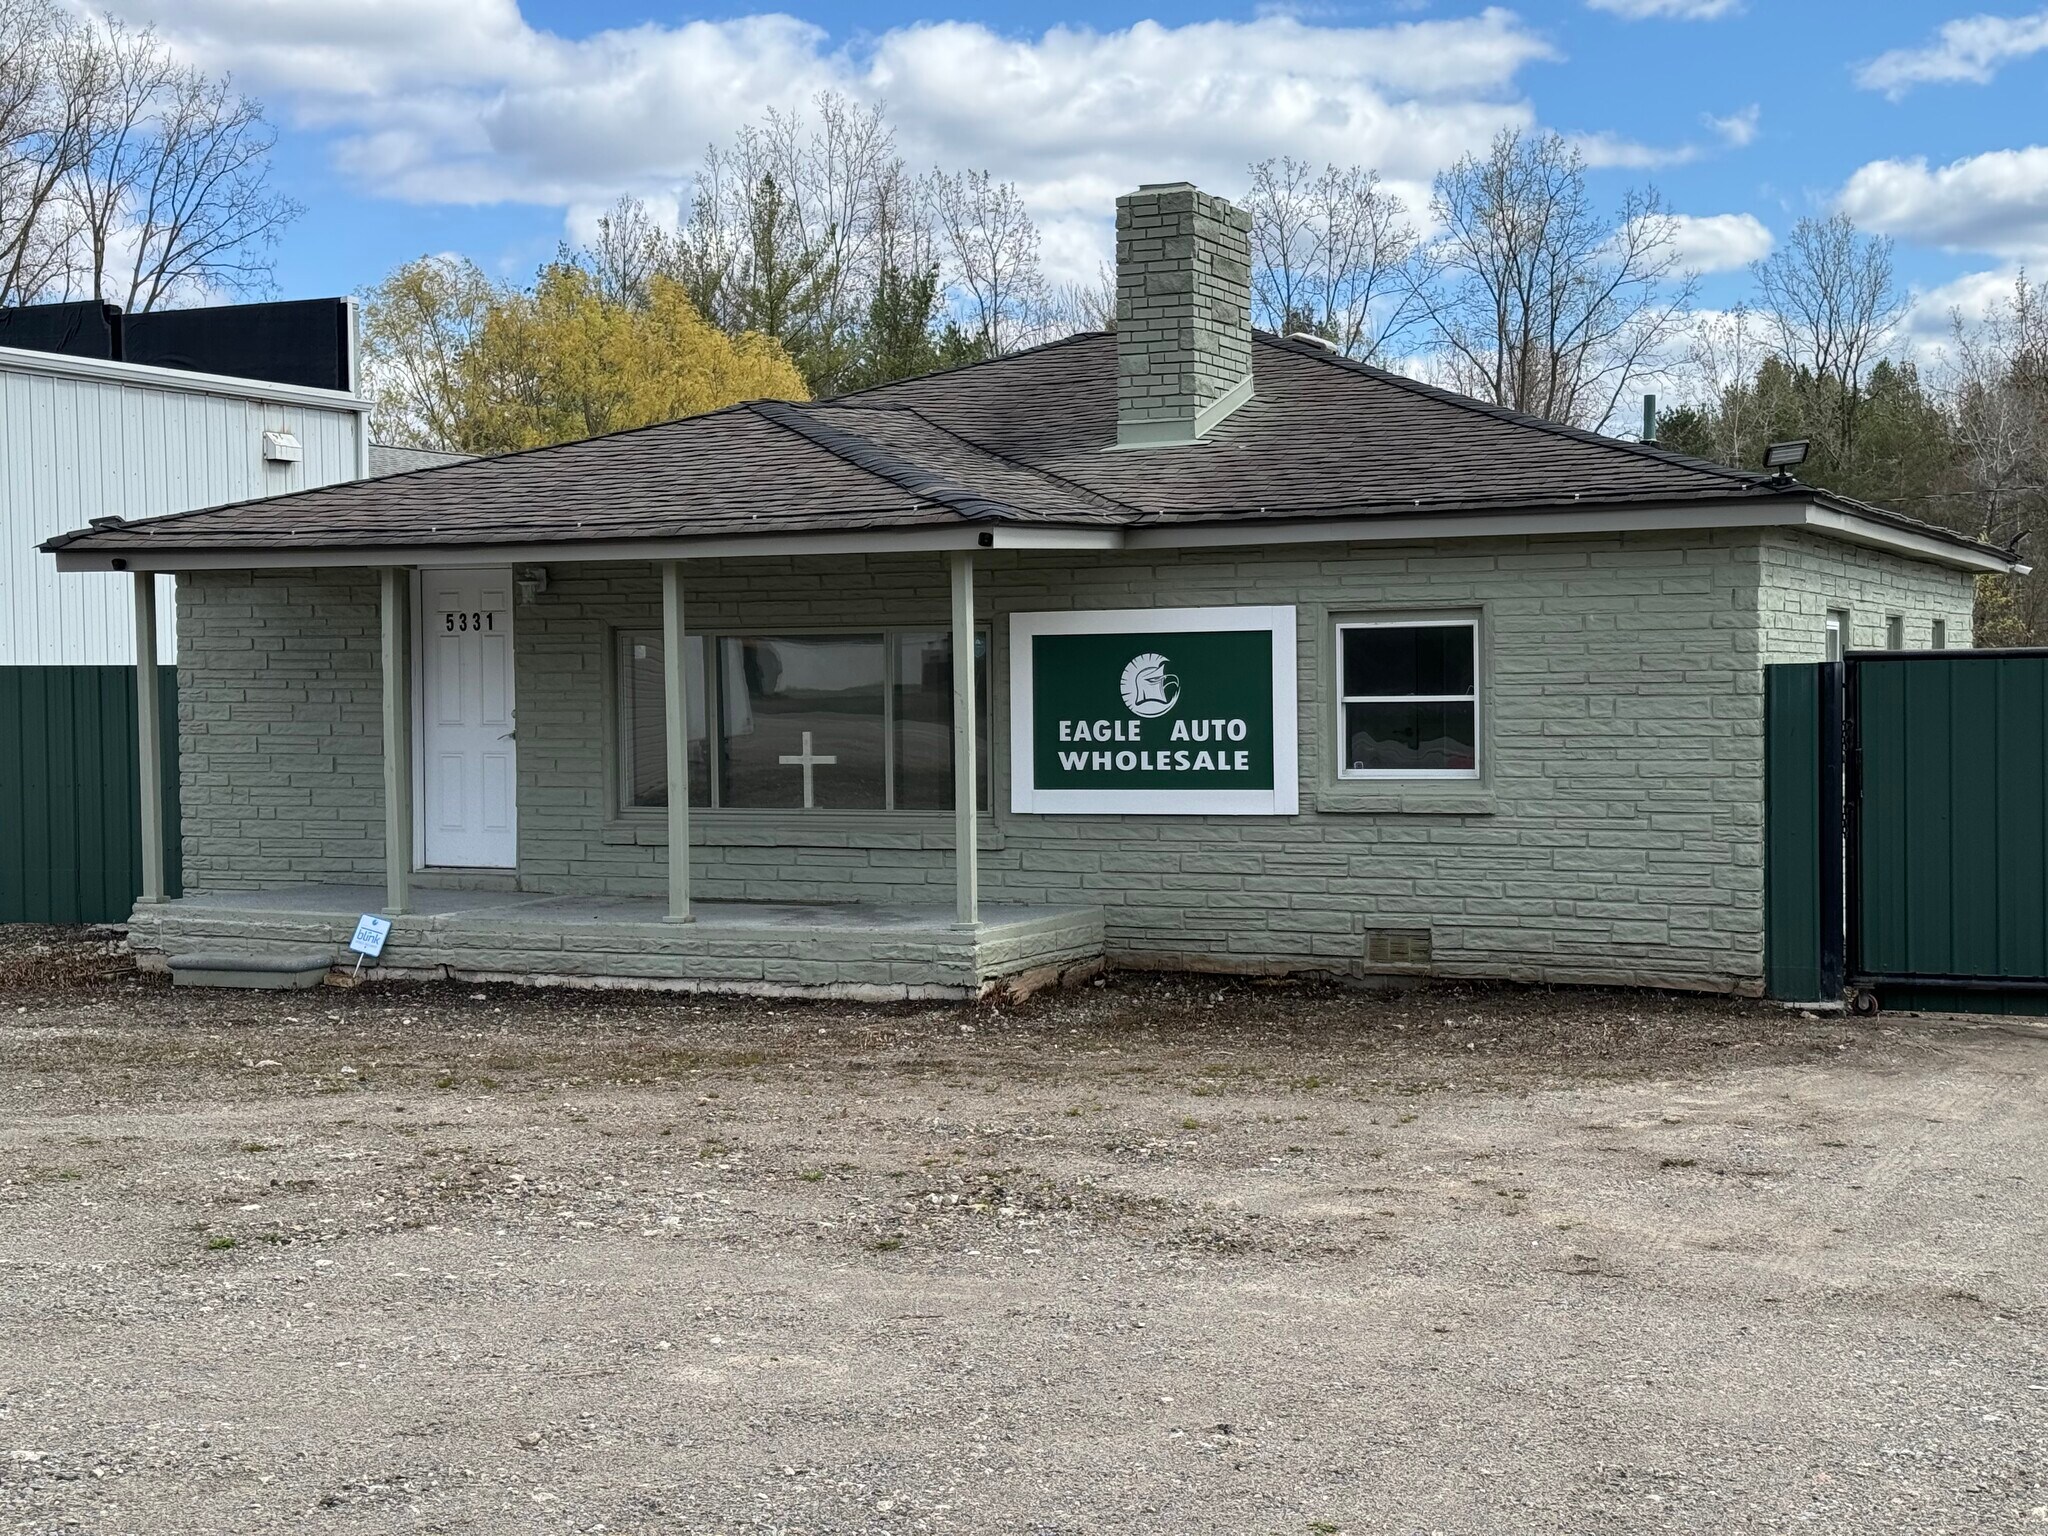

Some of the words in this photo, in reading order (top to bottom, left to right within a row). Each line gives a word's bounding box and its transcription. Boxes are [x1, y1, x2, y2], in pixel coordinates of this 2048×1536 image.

[446, 612, 493, 631] 5331
[1059, 720, 1141, 742] EAGLE
[1170, 719, 1247, 742] AUTO
[1058, 750, 1249, 771] WHOLESALE
[356, 929, 381, 945] blink
